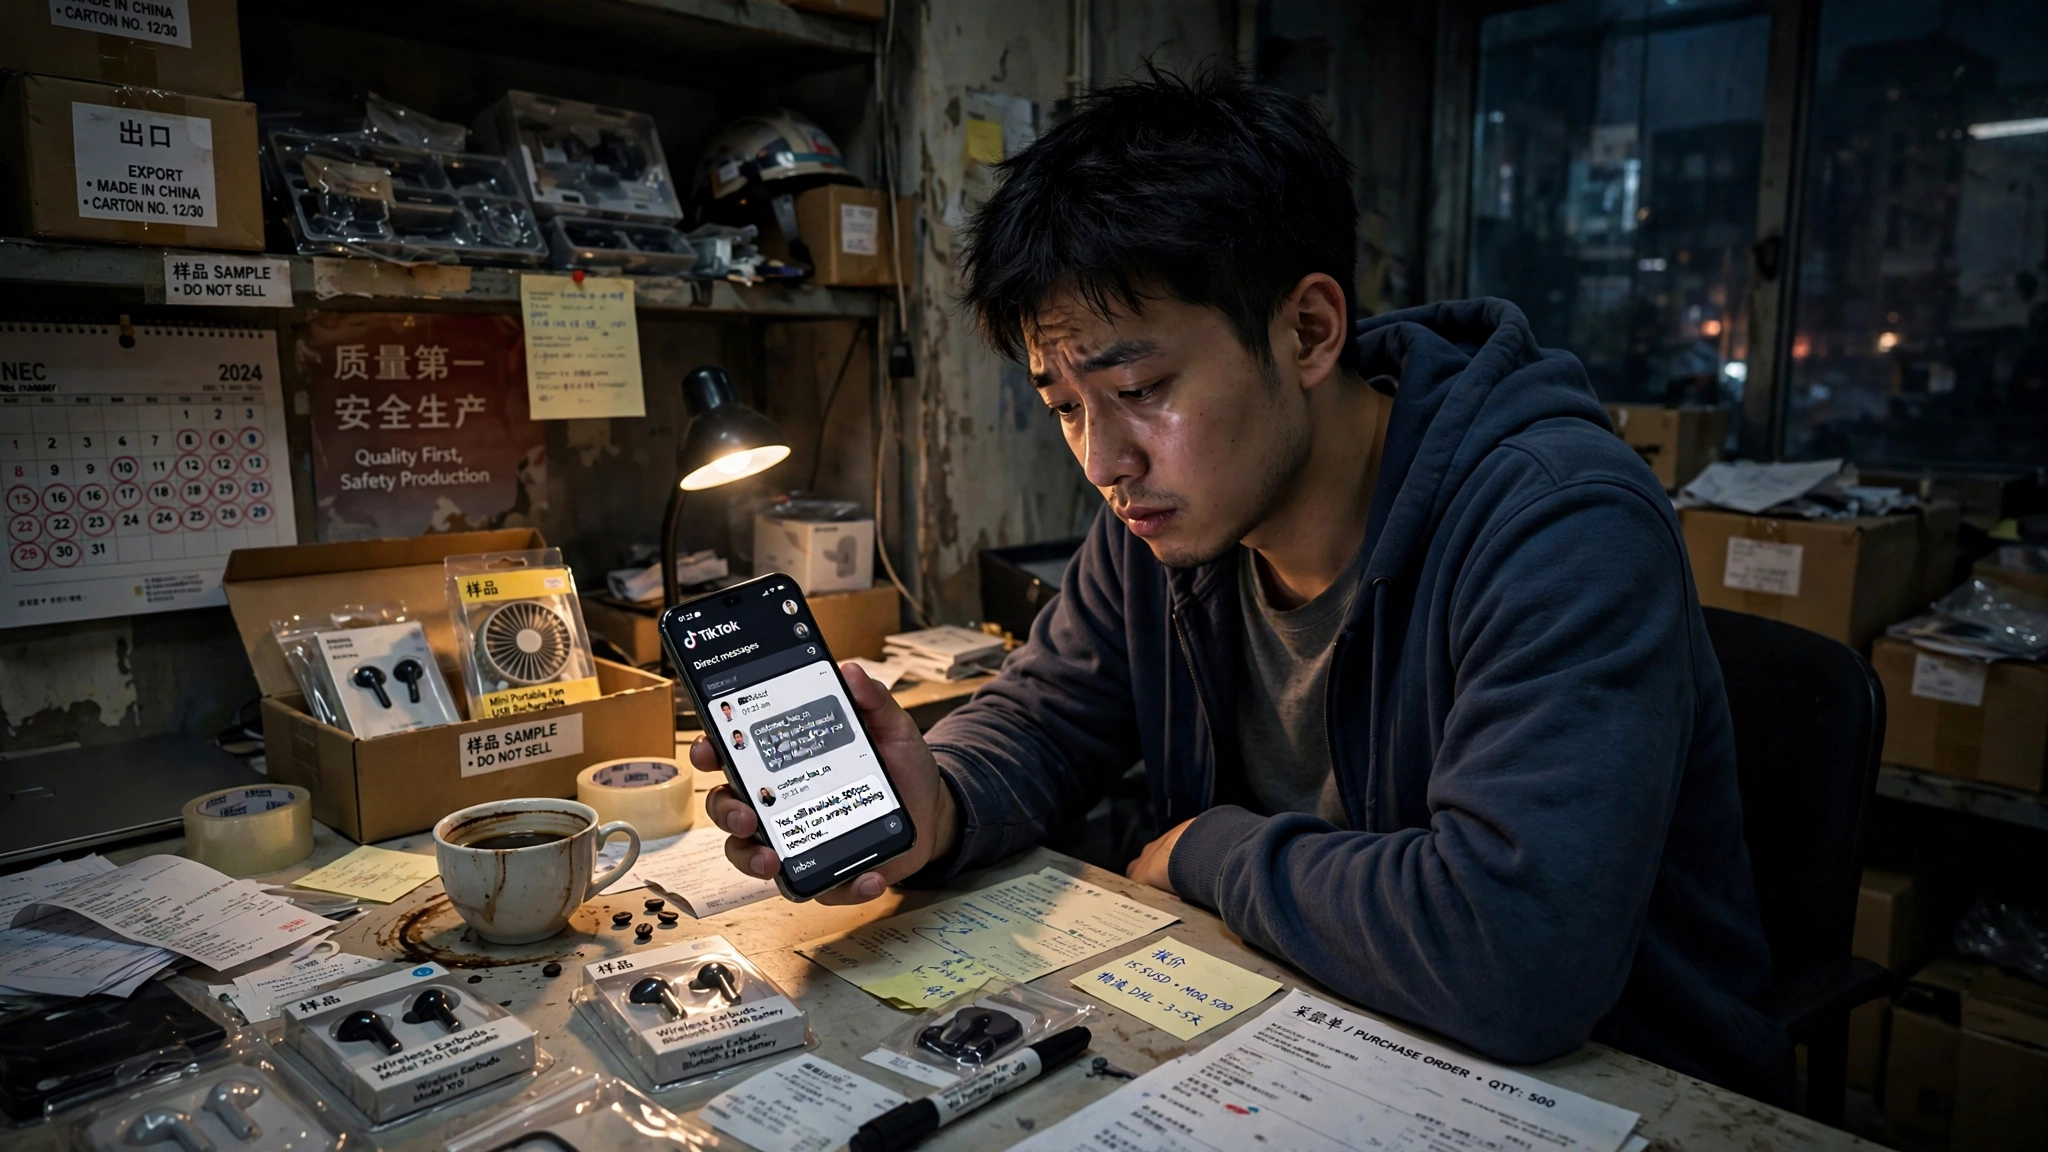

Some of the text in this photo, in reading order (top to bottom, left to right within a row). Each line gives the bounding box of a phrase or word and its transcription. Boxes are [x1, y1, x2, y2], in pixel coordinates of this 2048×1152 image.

[132, 1, 174, 19] CHINA
[65, 6, 177, 37] CARTON NO. 12/30
[120, 119, 170, 148] 出口
[128, 164, 183, 182] EXPORT
[97, 179, 201, 200] MADE IN CHINA
[92, 196, 203, 218] CARTON NO. 12/30
[172, 262, 271, 280] 样品 SAMPLE
[183, 283, 266, 297] DO NOT SELL
[1, 361, 263, 382] NEC 2024
[334, 343, 485, 381] 质量第一
[184, 409, 189, 420] 1
[214, 408, 222, 420] 2
[334, 393, 487, 431] 安全生产
[12, 439, 19, 450] 1
[48, 437, 57, 449] 2
[83, 437, 92, 448] 3
[118, 436, 127, 446] 6
[152, 435, 159, 446] 7
[355, 446, 463, 468] Quality First,
[14, 465, 24, 477] 8
[50, 464, 59, 476] 9
[86, 463, 95, 475] 9
[117, 462, 133, 473] 10
[153, 461, 166, 472] 11
[340, 467, 490, 492] Safety Production
[14, 494, 31, 505] 15
[51, 492, 67, 503] 16
[86, 490, 102, 501] 16
[120, 488, 135, 499] 17
[17, 521, 33, 532] 22
[53, 518, 70, 530] 22
[88, 516, 105, 528] 23
[122, 514, 139, 526] 24
[156, 512, 172, 524] 24
[56, 545, 73, 557] 30
[91, 543, 105, 555] 31
[466, 580, 499, 598] 样品
[697, 620, 741, 641] TikTok
[693, 642, 759, 670] Direct messages
[467, 723, 558, 755] 样品 SAMPLE
[477, 741, 552, 768] DO NOT SELL
[811, 816, 825, 827] can
[792, 858, 817, 874] Inbox
[596, 959, 634, 974] 样品
[1127, 987, 1151, 1004] DHL
[1179, 986, 1208, 1003] MOQ
[1209, 998, 1234, 1011] 500
[655, 1020, 709, 1037] Wireless
[710, 1006, 757, 1022] Earbuds
[372, 1048, 433, 1073] Wireless
[433, 1030, 488, 1051] Earbuds
[379, 1061, 419, 1080] Model
[1353, 1029, 1422, 1060] PURCHASE
[1423, 1055, 1471, 1079] ORDER
[1488, 1079, 1524, 1098] QTY:
[1528, 1092, 1556, 1108] 500
